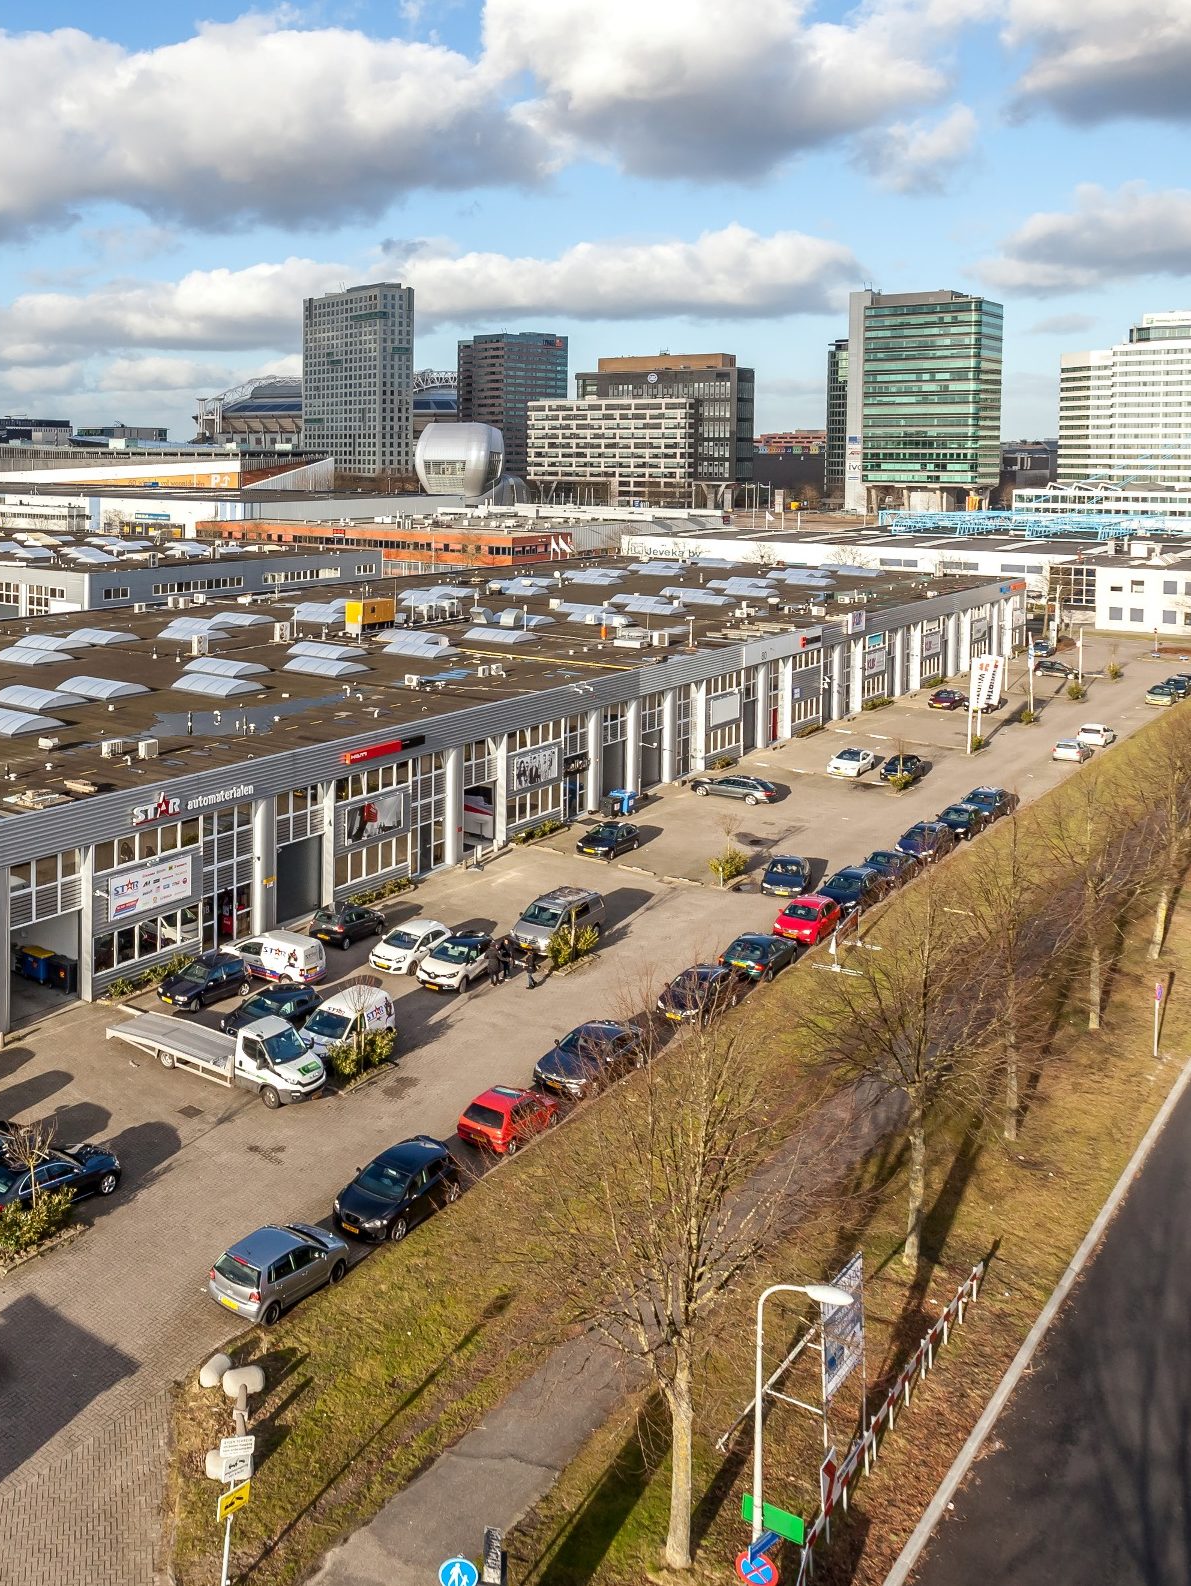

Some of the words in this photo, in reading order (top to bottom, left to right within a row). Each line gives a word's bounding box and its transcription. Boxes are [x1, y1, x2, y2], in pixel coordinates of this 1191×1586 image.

[646, 547, 685, 558] Jeveka
[132, 791, 181, 826] STAR
[187, 784, 254, 810] automaterialen
[113, 878, 139, 898] STAR
